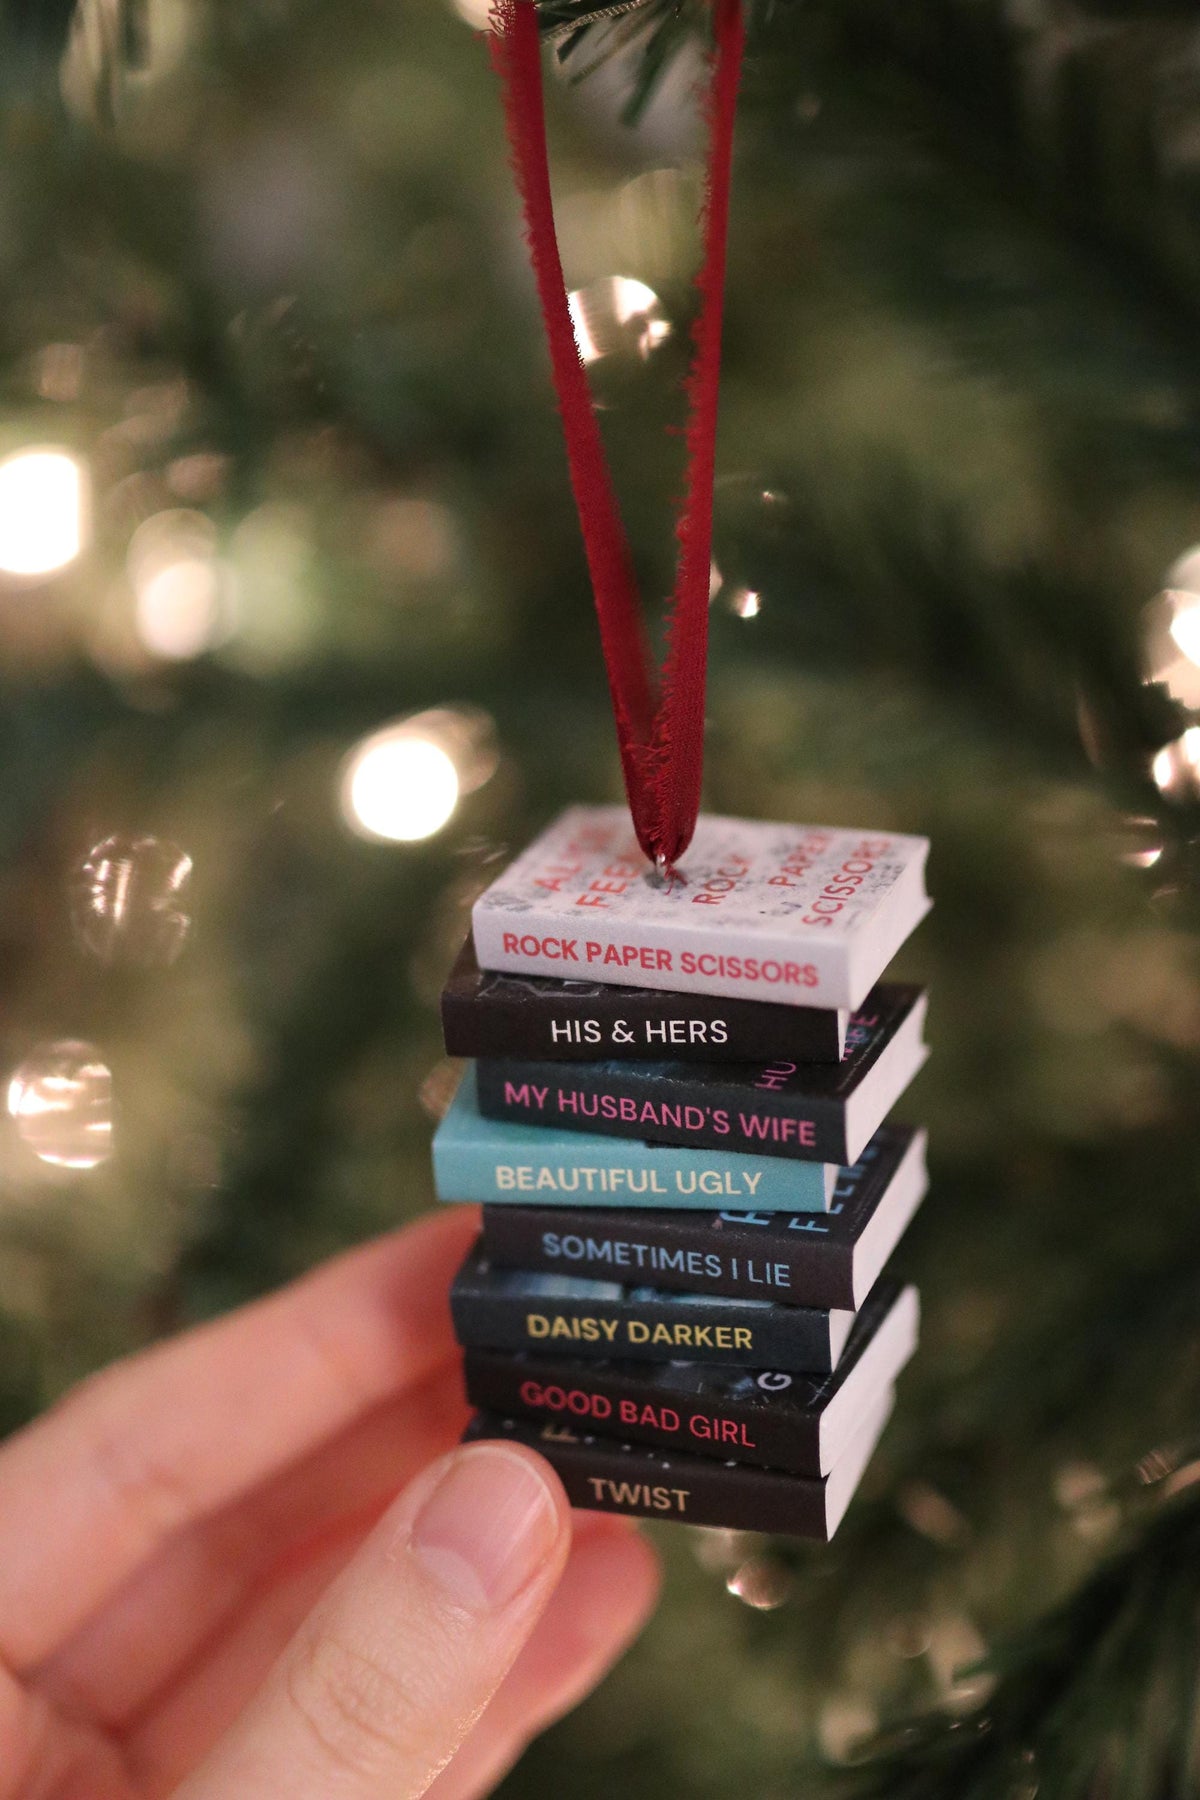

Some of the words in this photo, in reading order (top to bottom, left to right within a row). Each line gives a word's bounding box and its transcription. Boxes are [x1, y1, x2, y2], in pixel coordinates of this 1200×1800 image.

[502, 932, 579, 962] ROCK
[585, 941, 673, 972] PAPER
[680, 951, 820, 989] SCISSORS
[551, 1019, 602, 1043] HIS
[611, 1019, 636, 1043] &
[645, 1019, 728, 1043] HERS
[504, 1082, 549, 1108] MY
[558, 1089, 730, 1134] HUSBAND'S
[739, 1114, 816, 1147] WIFE
[494, 1165, 667, 1194] BEAUTIFUL
[676, 1171, 763, 1196] UGLY
[541, 1232, 722, 1279] SOMETIMES
[731, 1259, 739, 1281] I
[747, 1260, 792, 1288] LIE
[526, 1314, 619, 1341] DAISY
[627, 1321, 754, 1350] DARKER
[519, 1380, 612, 1419] GOOD
[619, 1399, 681, 1432] BAD
[689, 1414, 756, 1449] GIRL
[588, 1477, 691, 1513] TWIST
